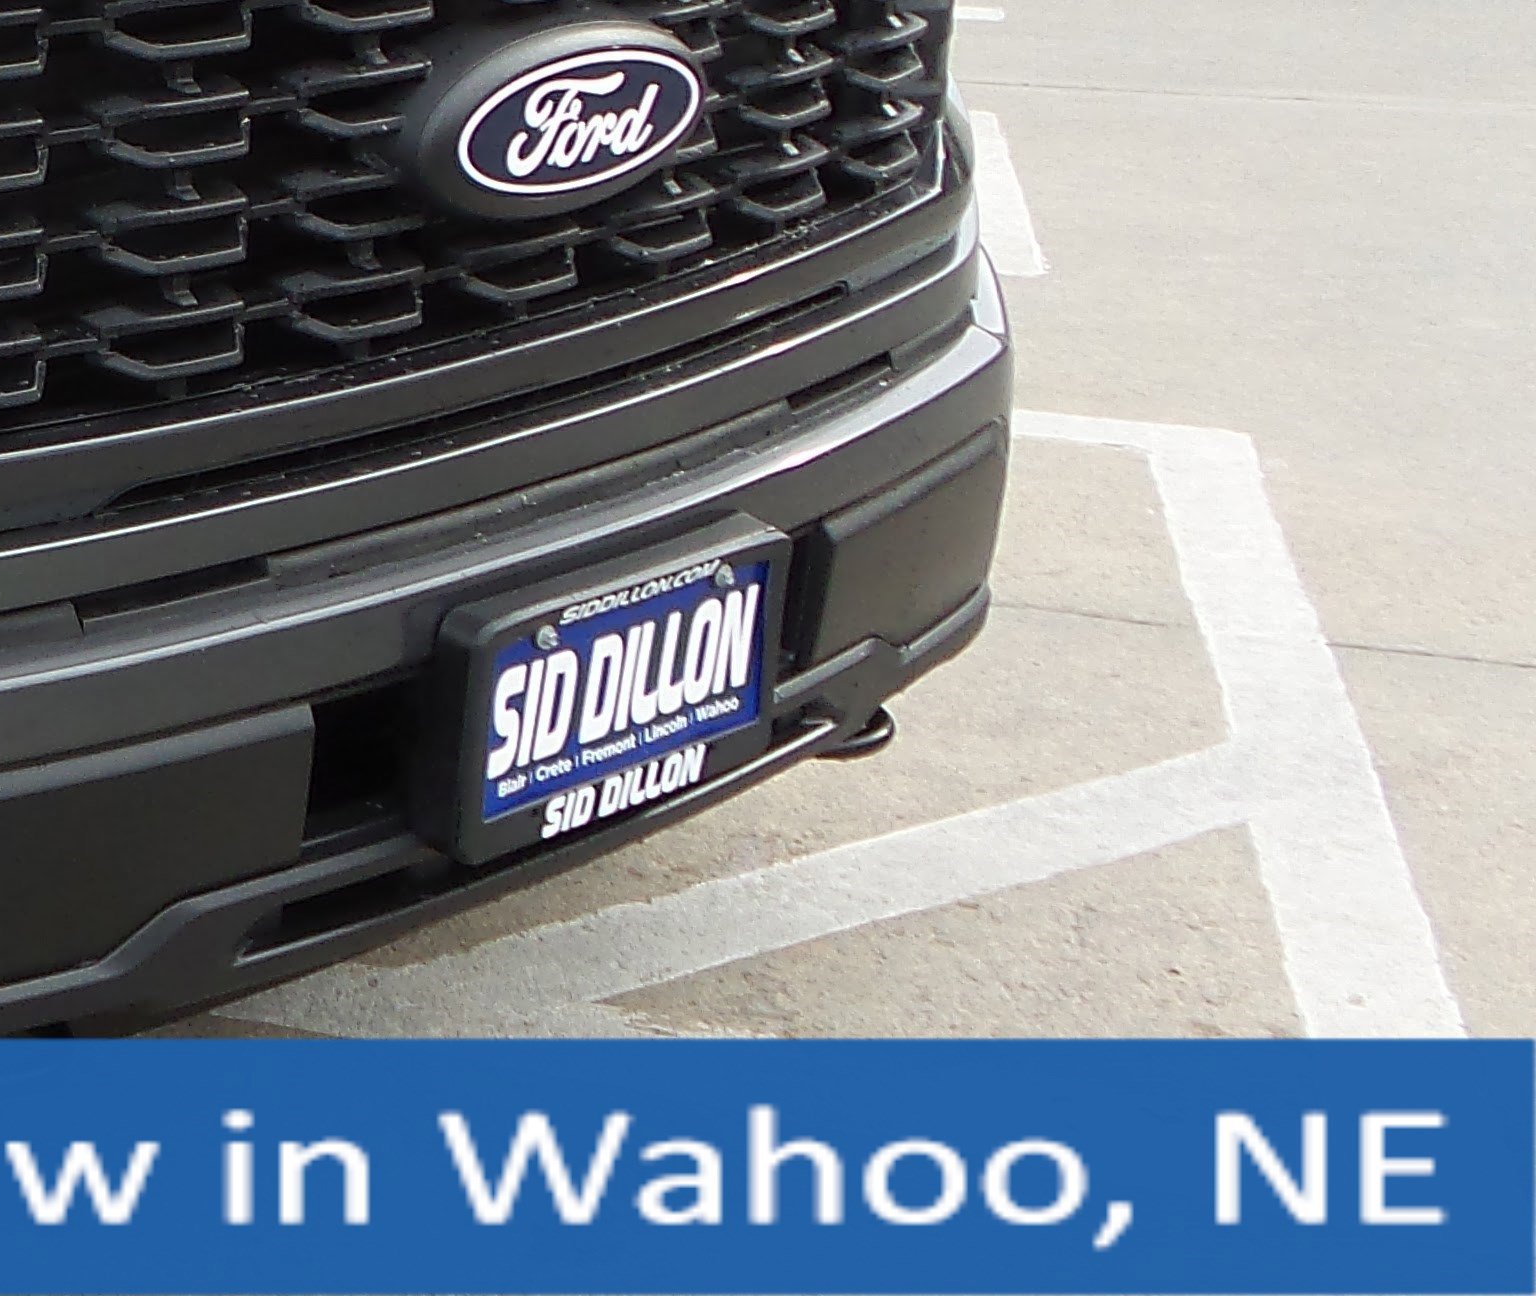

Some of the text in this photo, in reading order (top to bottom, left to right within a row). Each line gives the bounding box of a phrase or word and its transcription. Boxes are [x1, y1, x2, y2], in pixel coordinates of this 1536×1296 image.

[505, 70, 661, 178] Ford
[486, 583, 760, 781] SID DILLON
[497, 697, 741, 798] Blair Crete Fremont Lincoln Wahoo
[540, 743, 707, 839] SID DILLON
